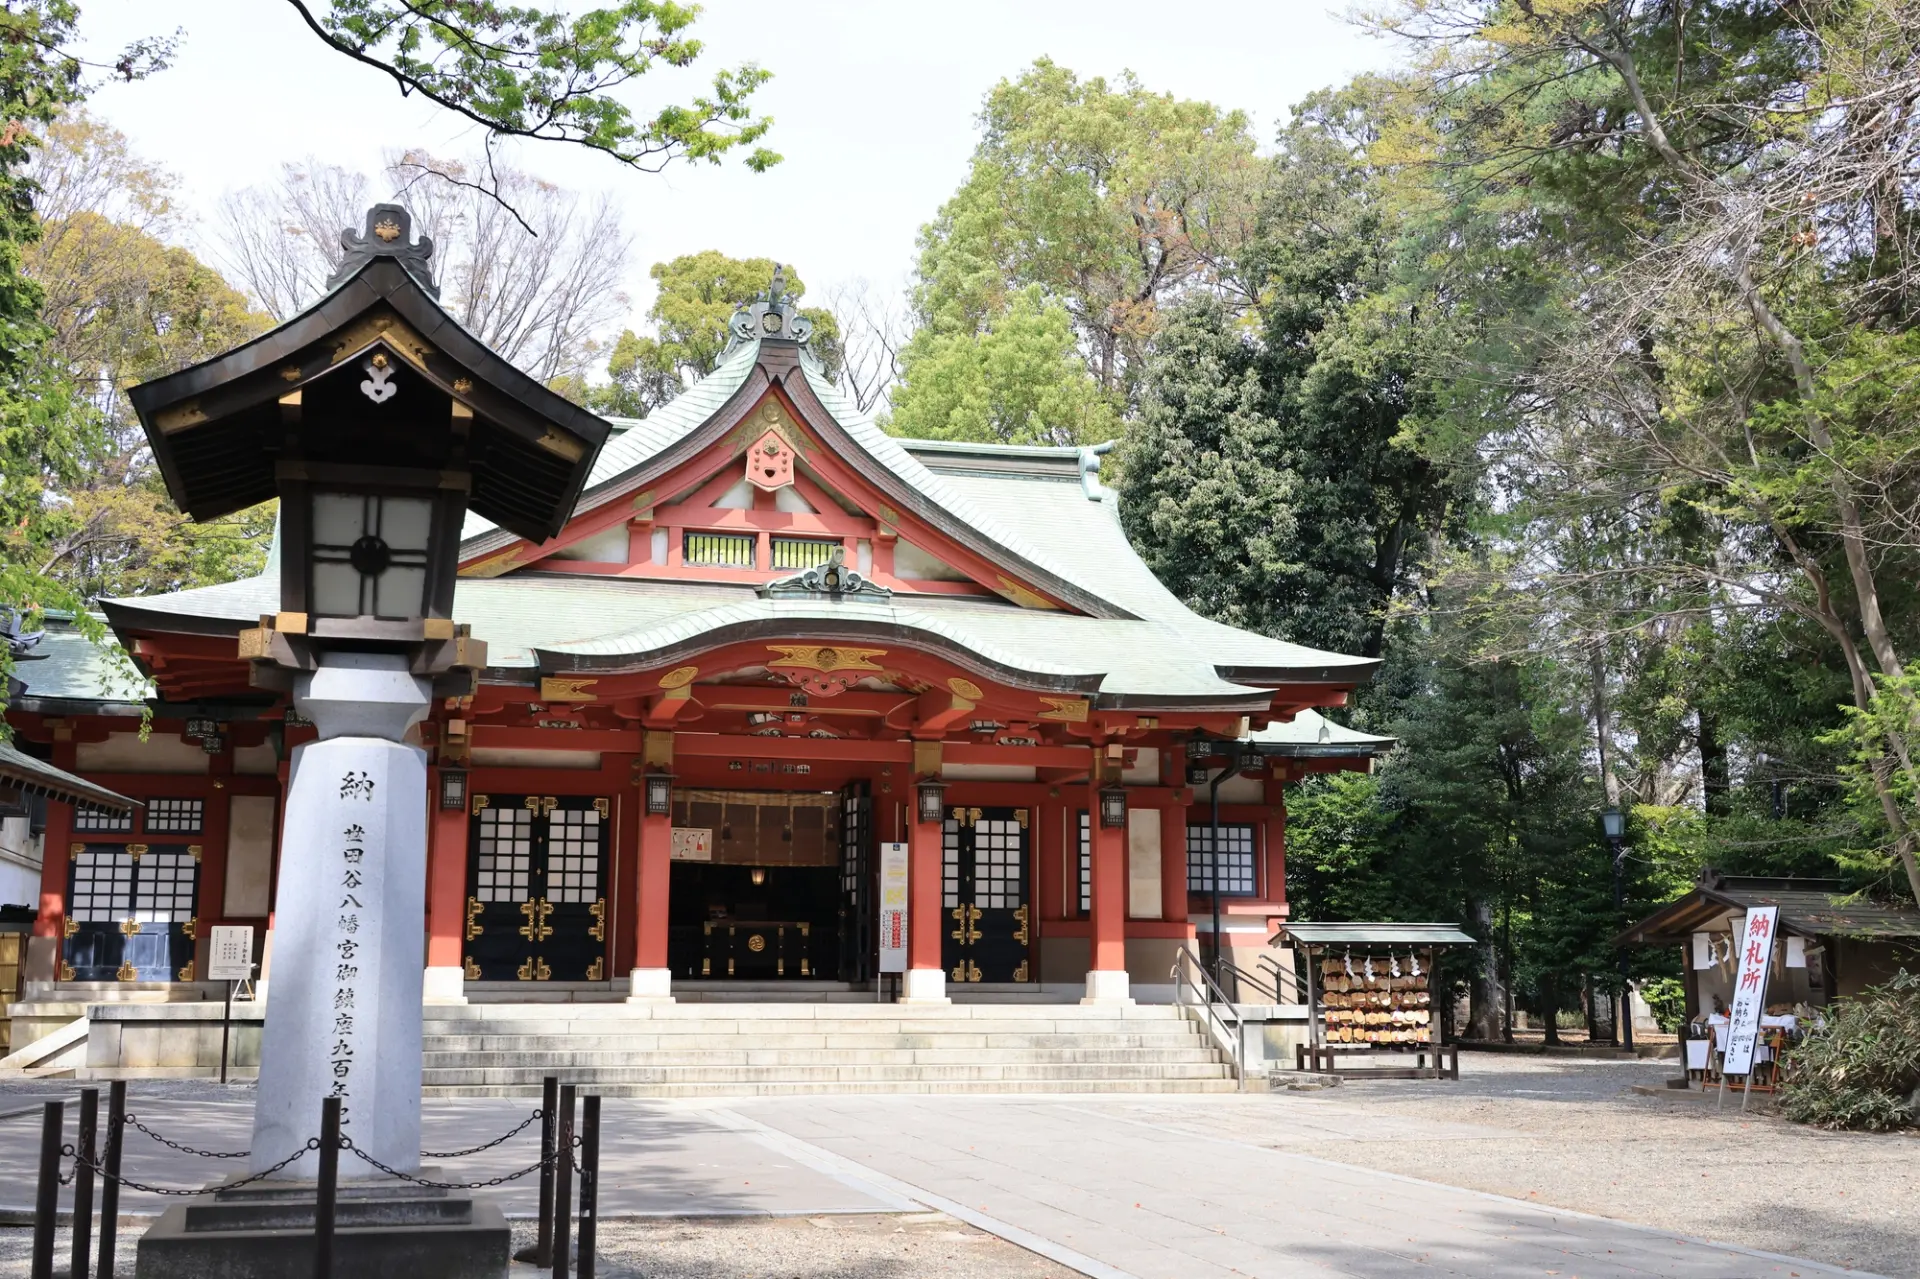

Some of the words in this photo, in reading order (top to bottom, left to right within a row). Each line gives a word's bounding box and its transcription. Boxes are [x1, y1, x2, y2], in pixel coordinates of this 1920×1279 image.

[329, 823, 366, 1143] 世田谷八幡宮御鎮座九百年
[1740, 914, 1769, 994] 納札所
